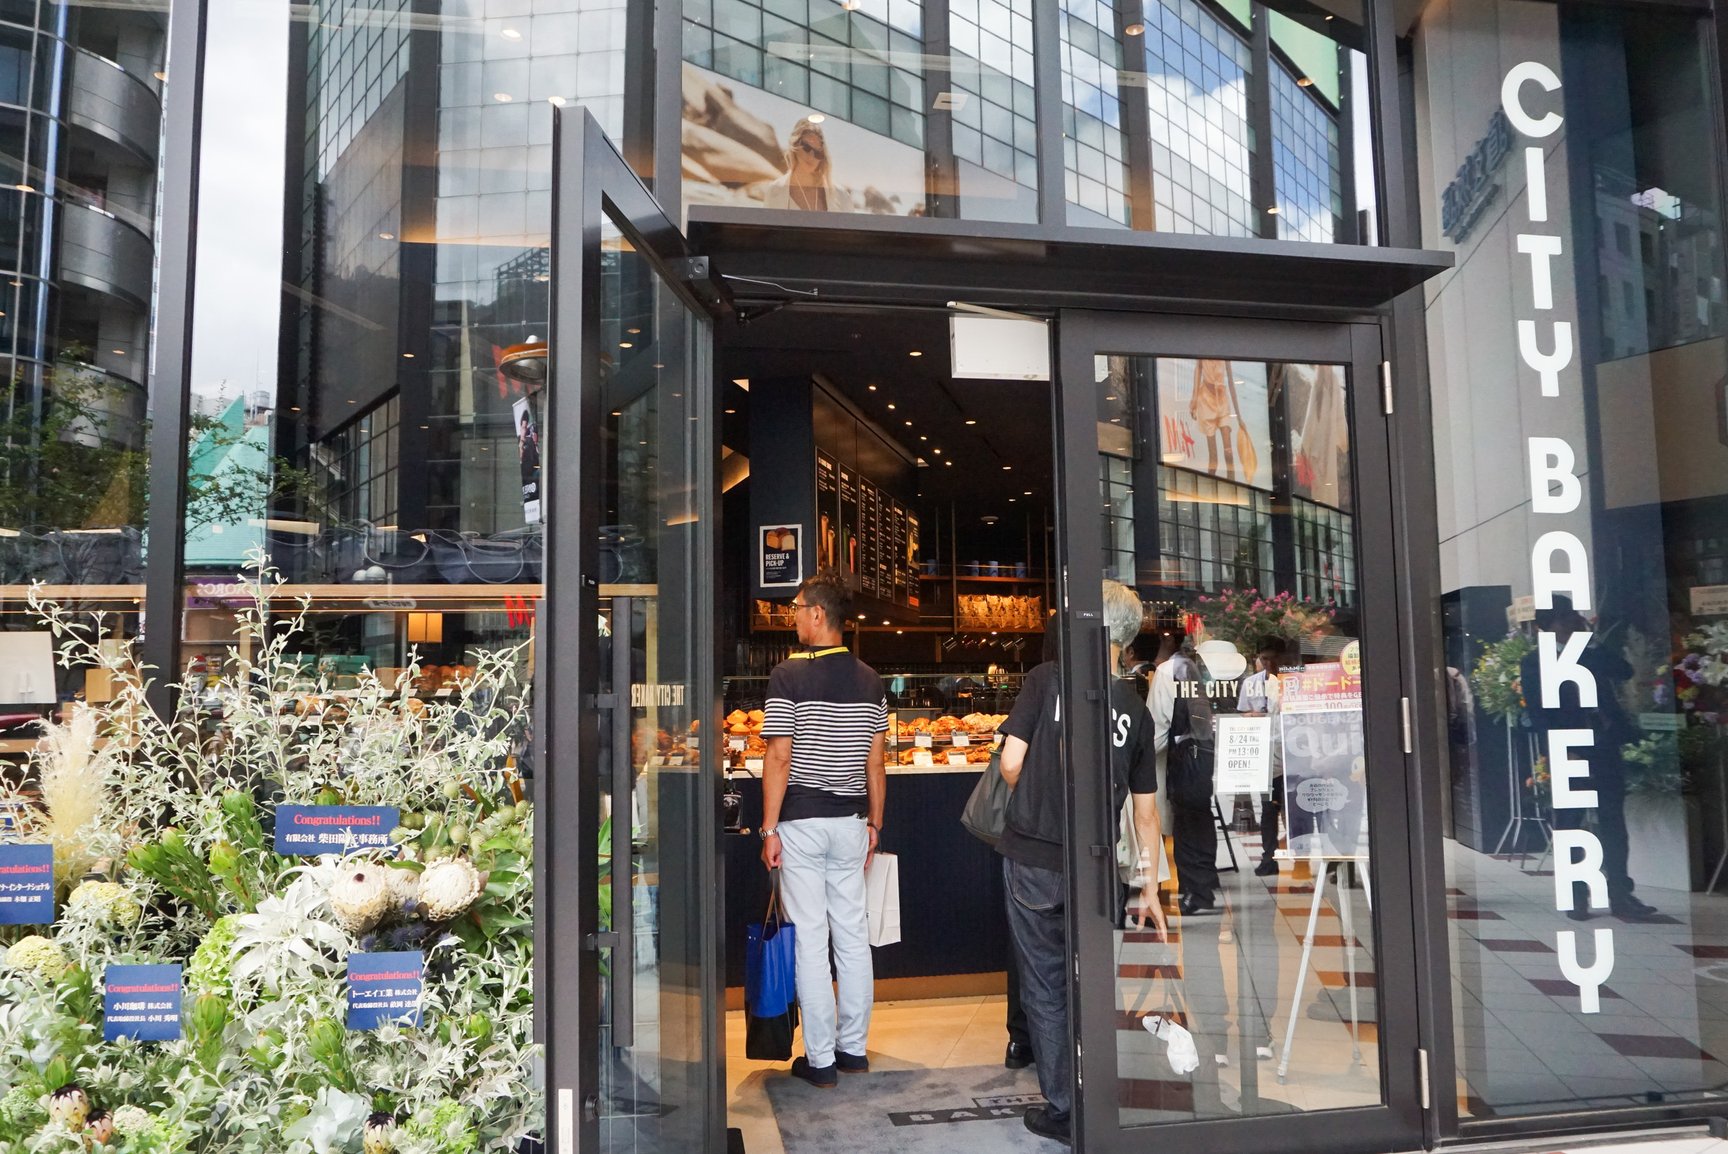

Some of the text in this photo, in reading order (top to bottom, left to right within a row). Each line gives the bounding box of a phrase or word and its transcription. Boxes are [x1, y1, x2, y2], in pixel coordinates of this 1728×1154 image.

[1501, 61, 1614, 1014] CITY BAKERY
[1174, 681, 1198, 698] THE
[1206, 681, 1238, 698] CITY
[1229, 735, 1248, 744] 8/24
[1238, 747, 1259, 756] 13:00
[1228, 760, 1251, 768] OPEN!
[294, 814, 381, 826] Congratulations!!
[350, 970, 419, 981] Congratulations!!
[107, 983, 179, 993] Congratulations!!
